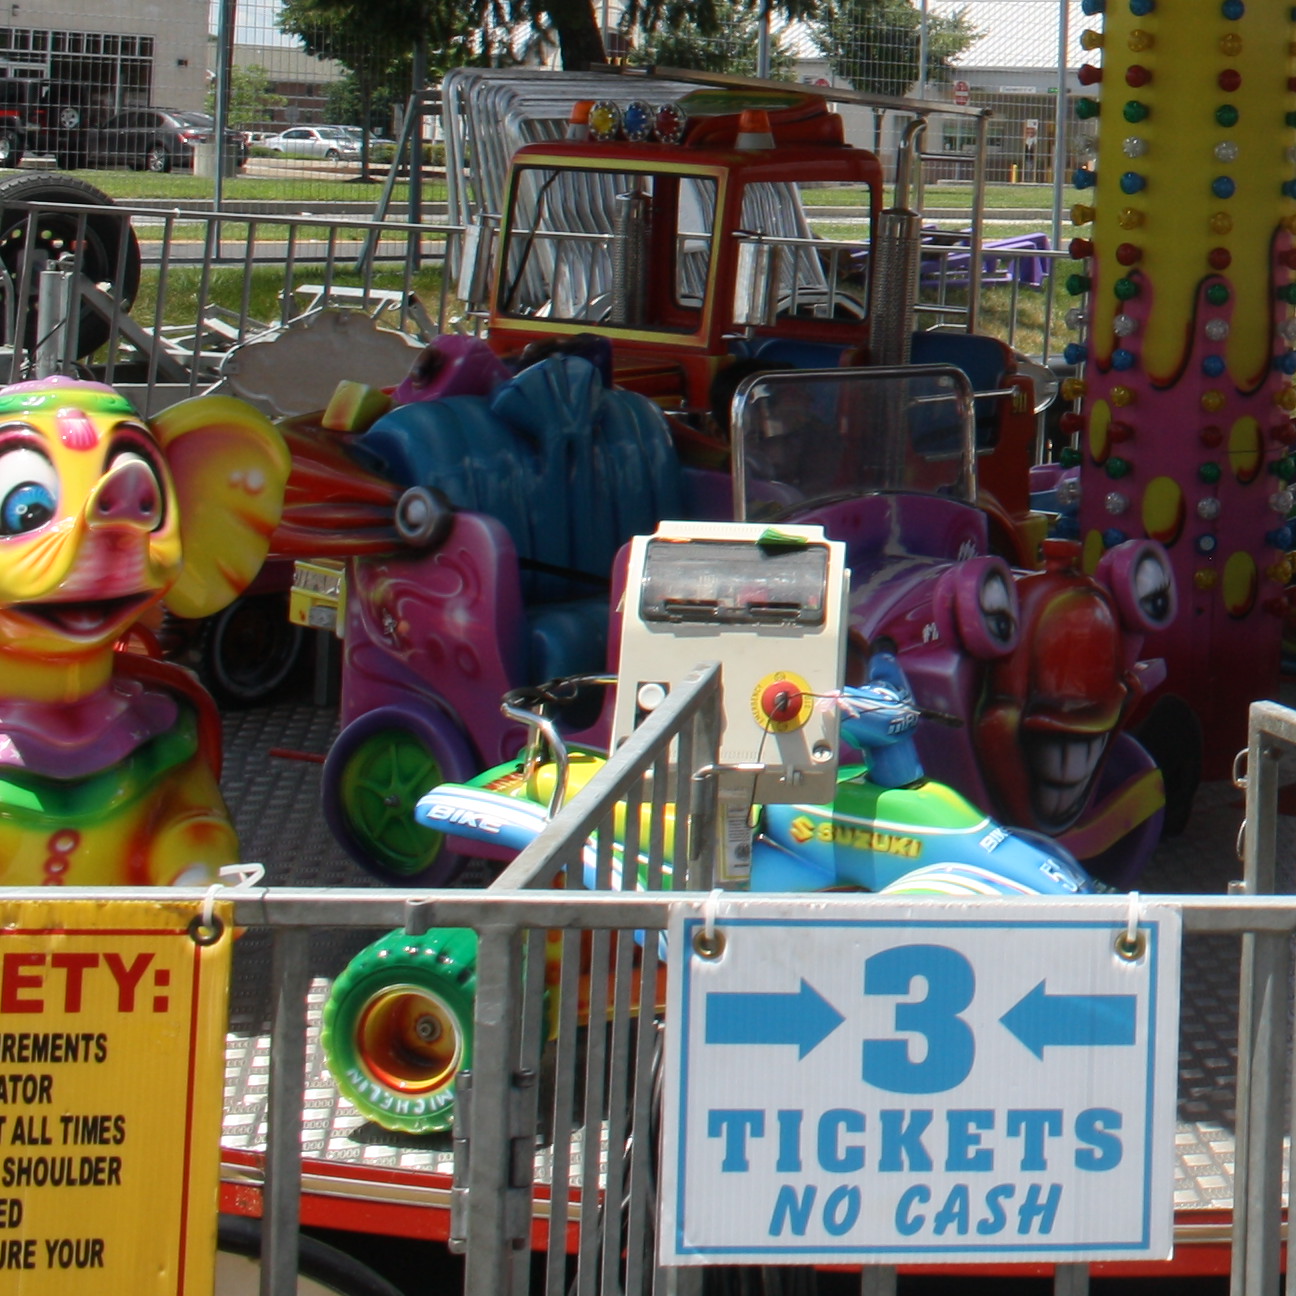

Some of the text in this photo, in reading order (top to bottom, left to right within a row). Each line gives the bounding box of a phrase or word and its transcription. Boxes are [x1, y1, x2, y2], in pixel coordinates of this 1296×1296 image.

[427, 804, 501, 834] BIKE
[818, 822, 922, 858] SUZUKI
[861, 944, 976, 1095] 3
[347, 1065, 455, 1115] MICHELIN
[10, 1115, 53, 1145] ALL
[60, 1115, 126, 1144] TIMES
[706, 1108, 1124, 1174] TICKETS
[2, 1156, 121, 1187] SHOULDER
[767, 1184, 1063, 1238] NO CASH
[45, 1238, 104, 1269] YOUR
